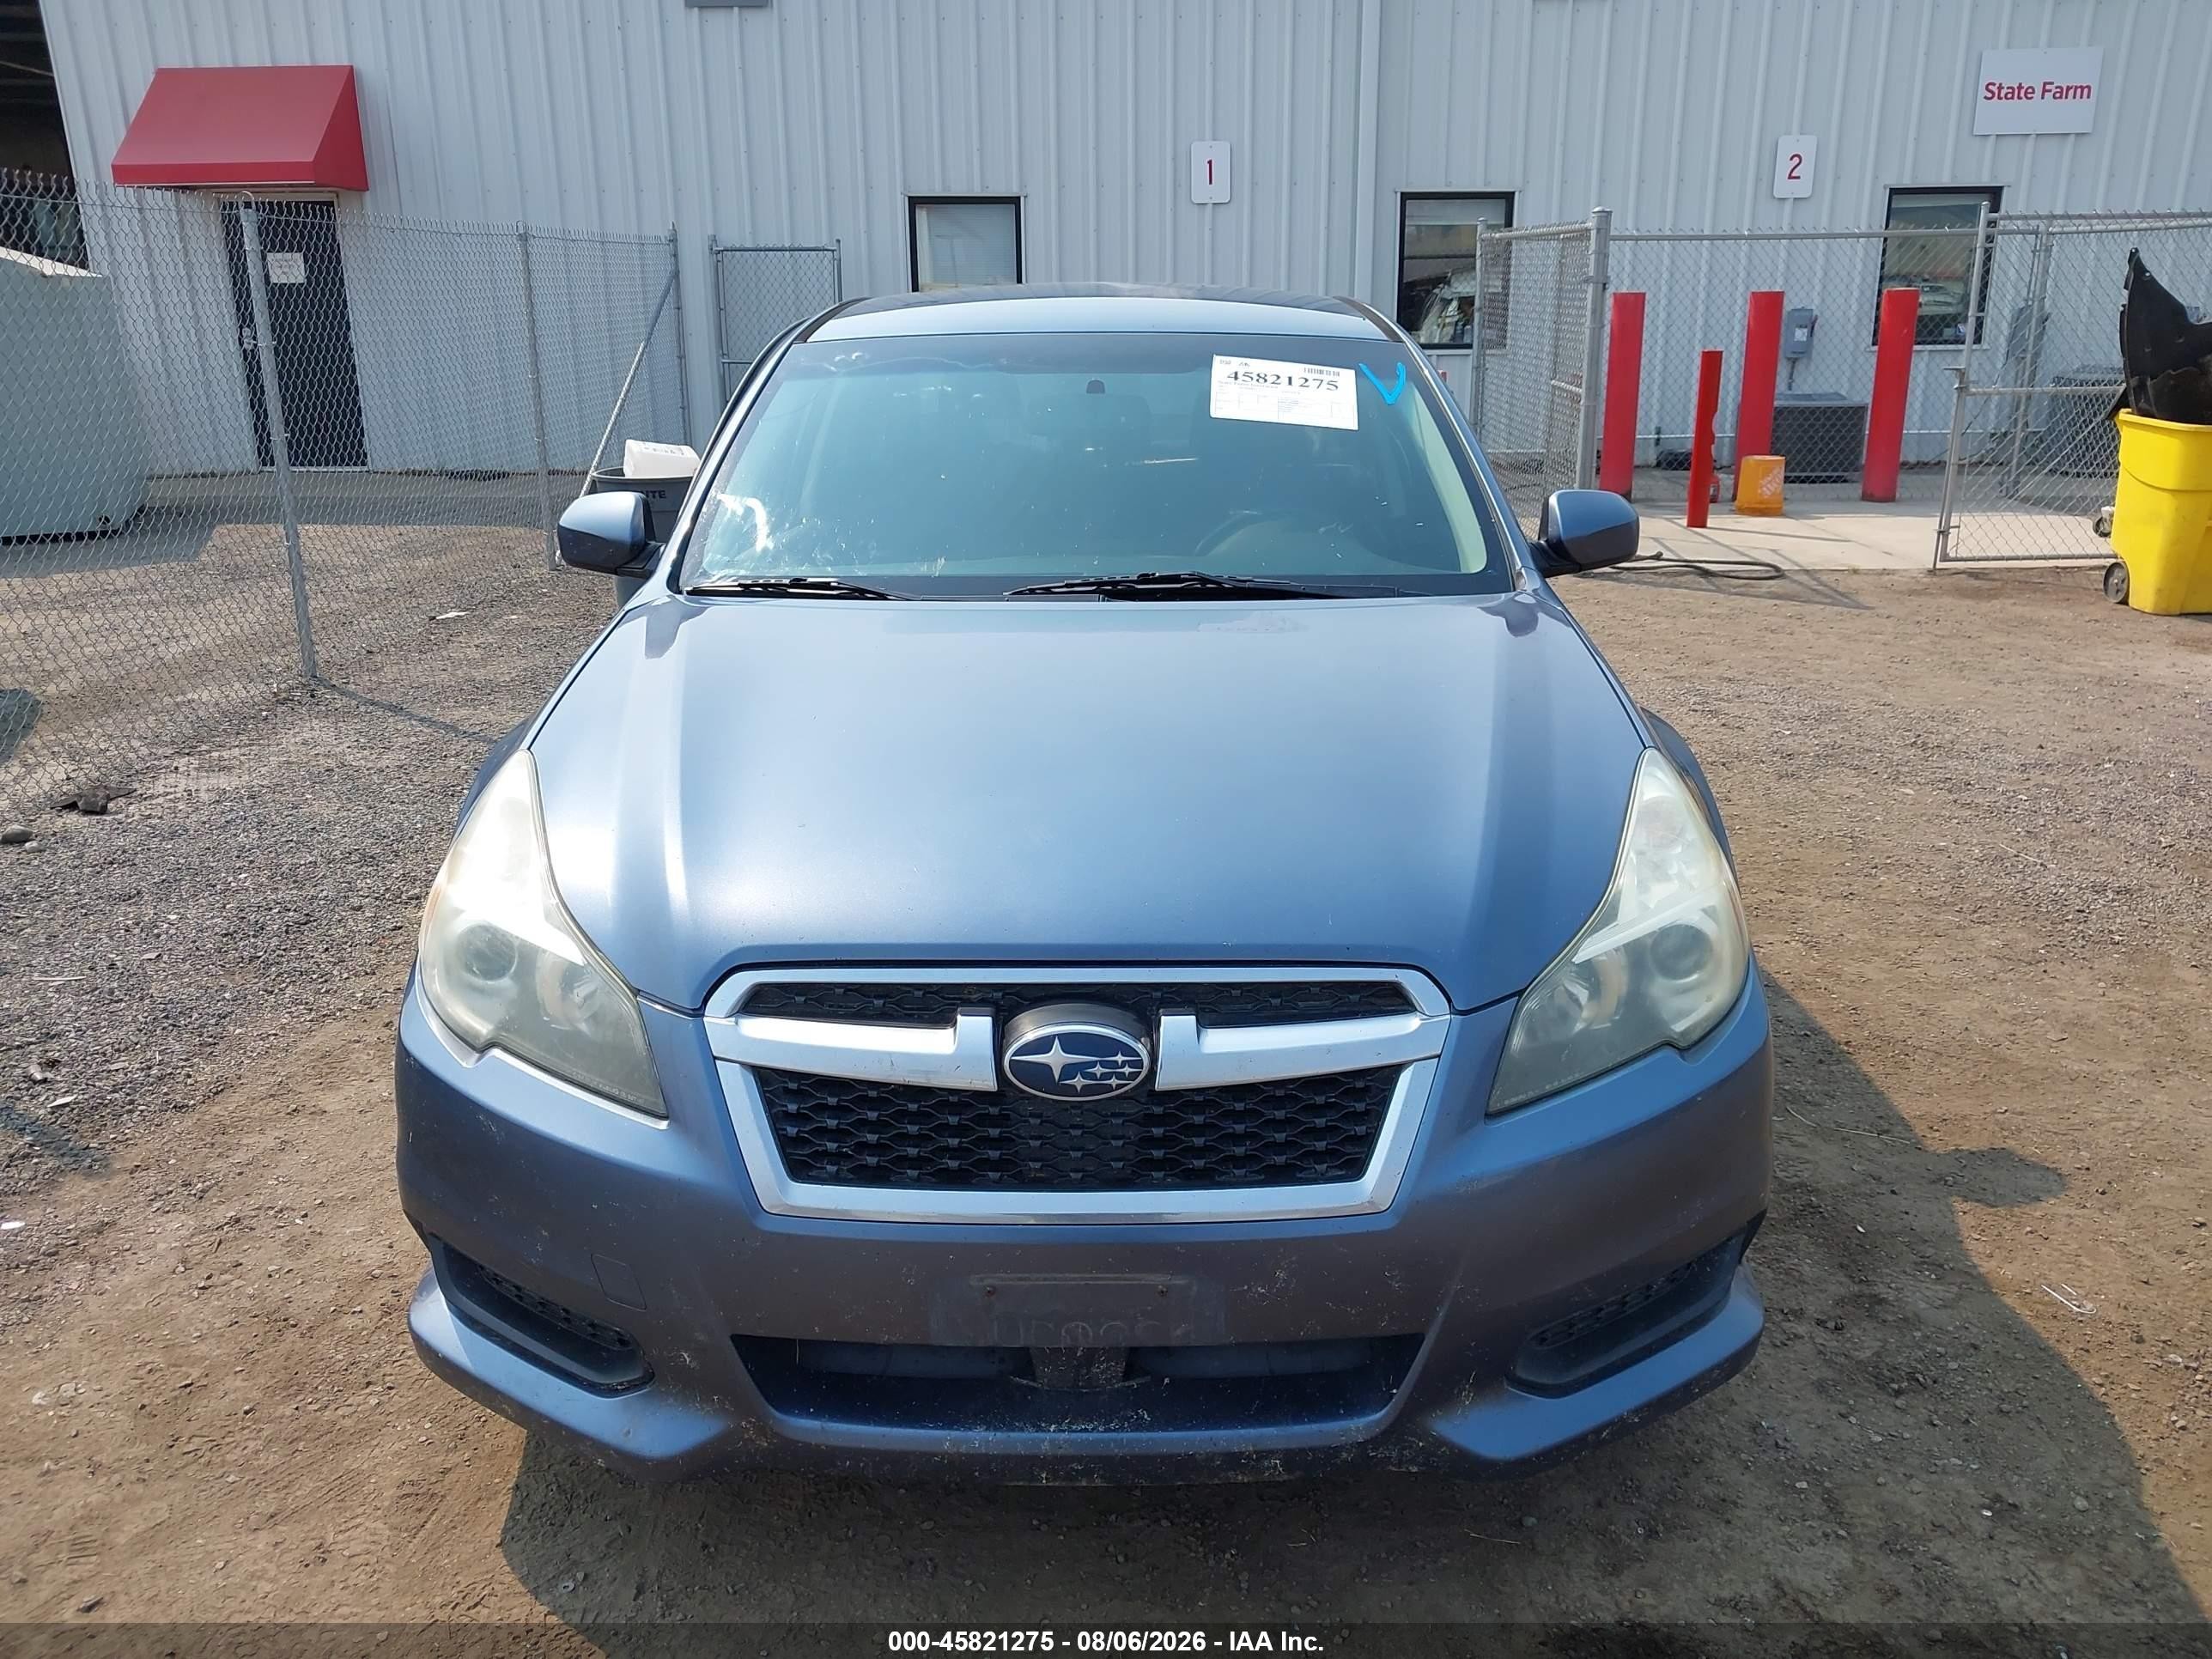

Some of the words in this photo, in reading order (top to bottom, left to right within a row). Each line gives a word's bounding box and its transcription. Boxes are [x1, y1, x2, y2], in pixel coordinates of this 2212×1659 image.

[1983, 82, 2036, 100] State
[2040, 81, 2093, 100] Farm
[1206, 159, 1213, 185] 1
[1787, 153, 1803, 180] 2
[1226, 369, 1340, 392] 45821275
